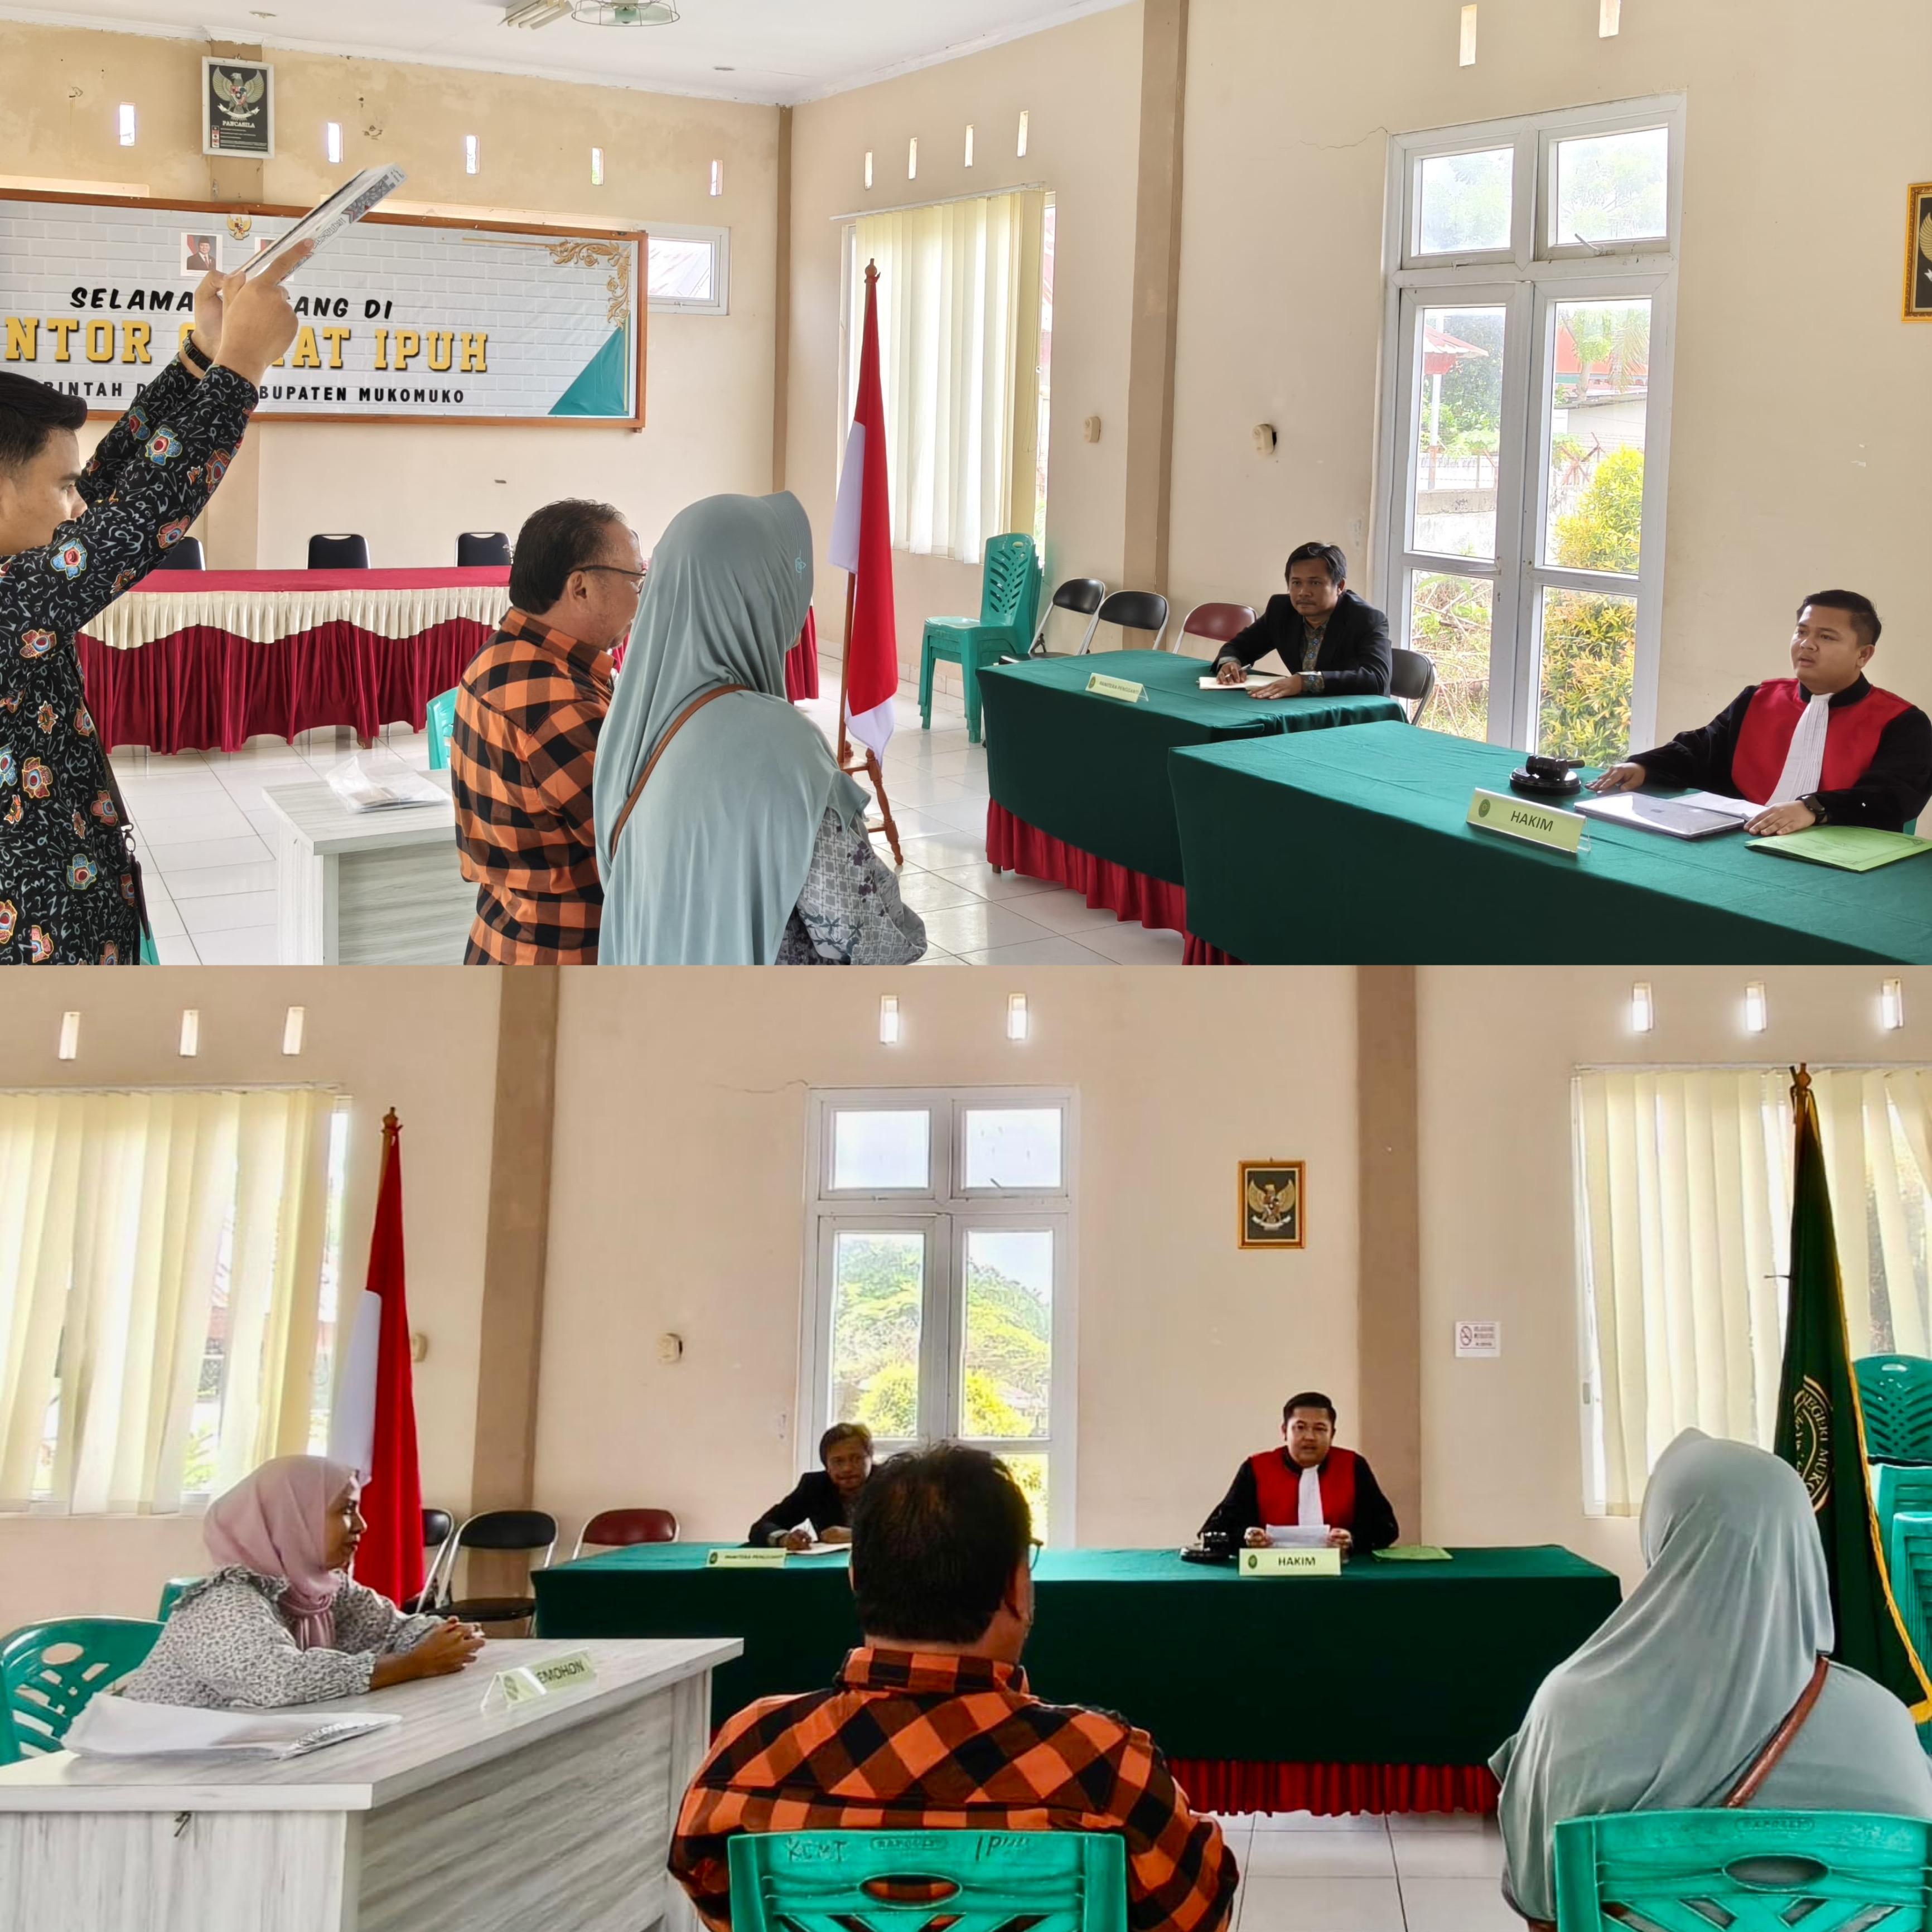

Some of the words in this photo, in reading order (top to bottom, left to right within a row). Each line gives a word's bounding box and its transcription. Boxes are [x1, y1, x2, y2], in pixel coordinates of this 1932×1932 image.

[288, 296, 349, 317] ANG
[365, 297, 393, 320] DI
[5, 316, 152, 364] NTOR
[375, 329, 488, 372] IPUH
[359, 388, 463, 403] MUKOMUKO
[1510, 810, 1554, 832] HAKIM
[1278, 1557, 1316, 1566] HAKIM
